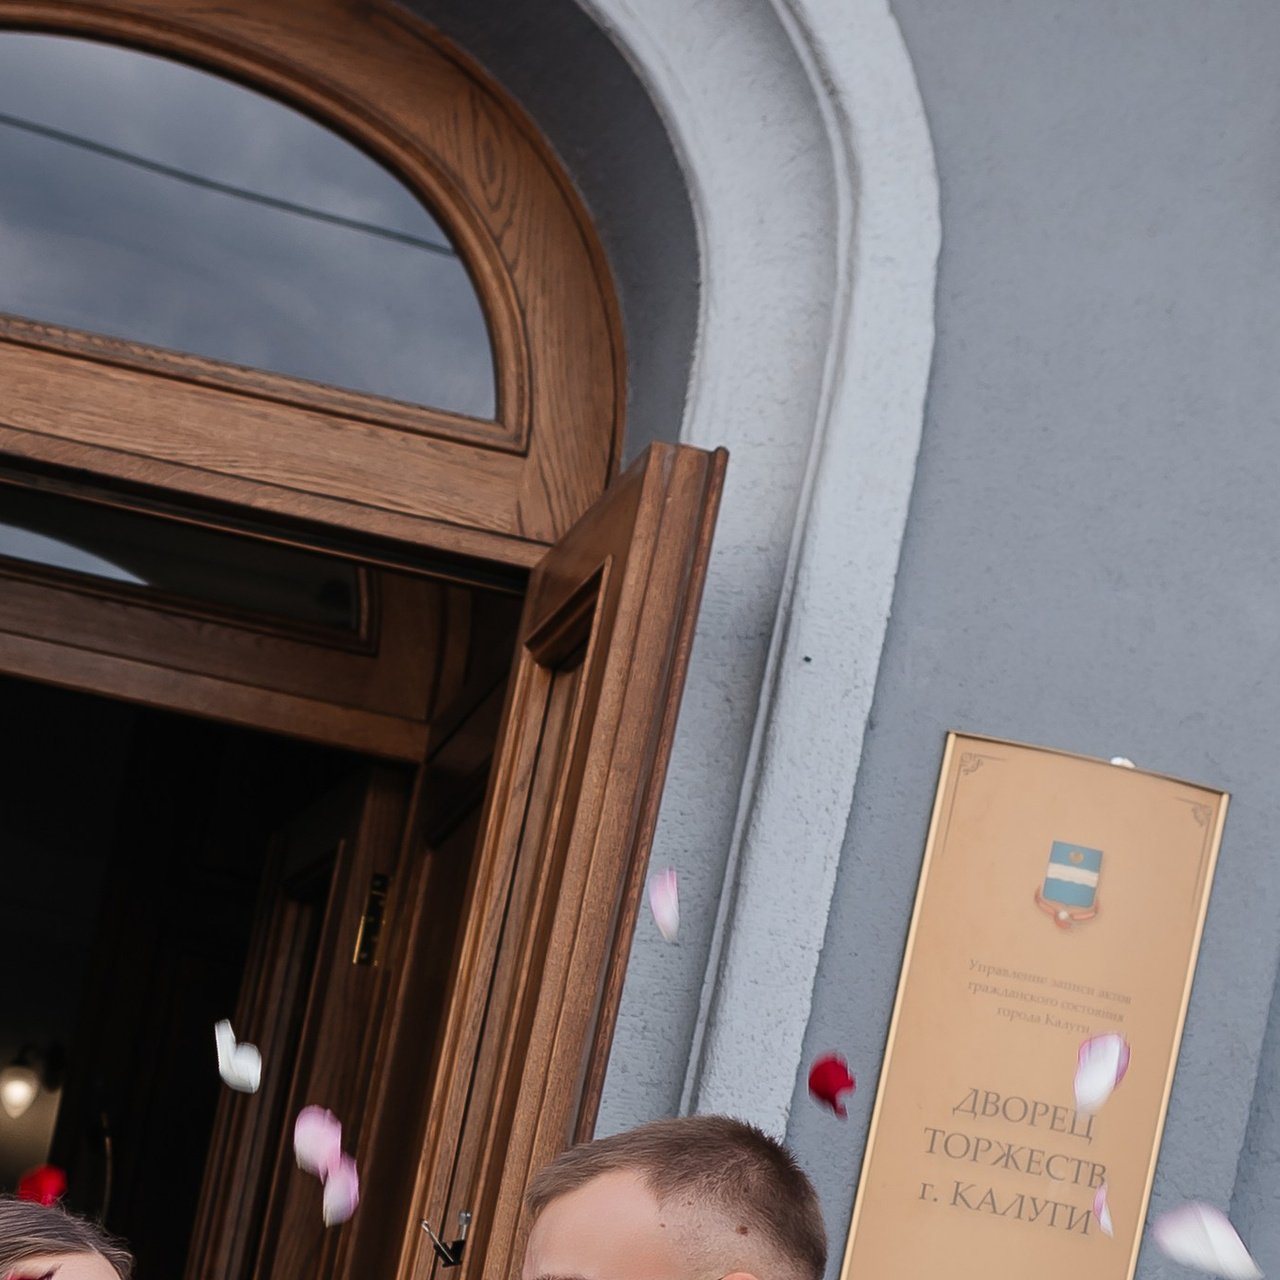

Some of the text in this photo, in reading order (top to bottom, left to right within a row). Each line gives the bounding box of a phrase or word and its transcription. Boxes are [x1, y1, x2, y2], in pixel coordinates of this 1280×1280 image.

[967, 981, 1125, 1023] гражданского состояния
[969, 958, 1132, 1005] Управление записи актов
[997, 1006, 1090, 1034] города Калуги
[952, 1087, 1097, 1146] ДВОРЕЦ
[924, 1126, 1108, 1190] ТОРЖЕСТВ
[918, 1180, 1093, 1236] г. КАЛУГИ
